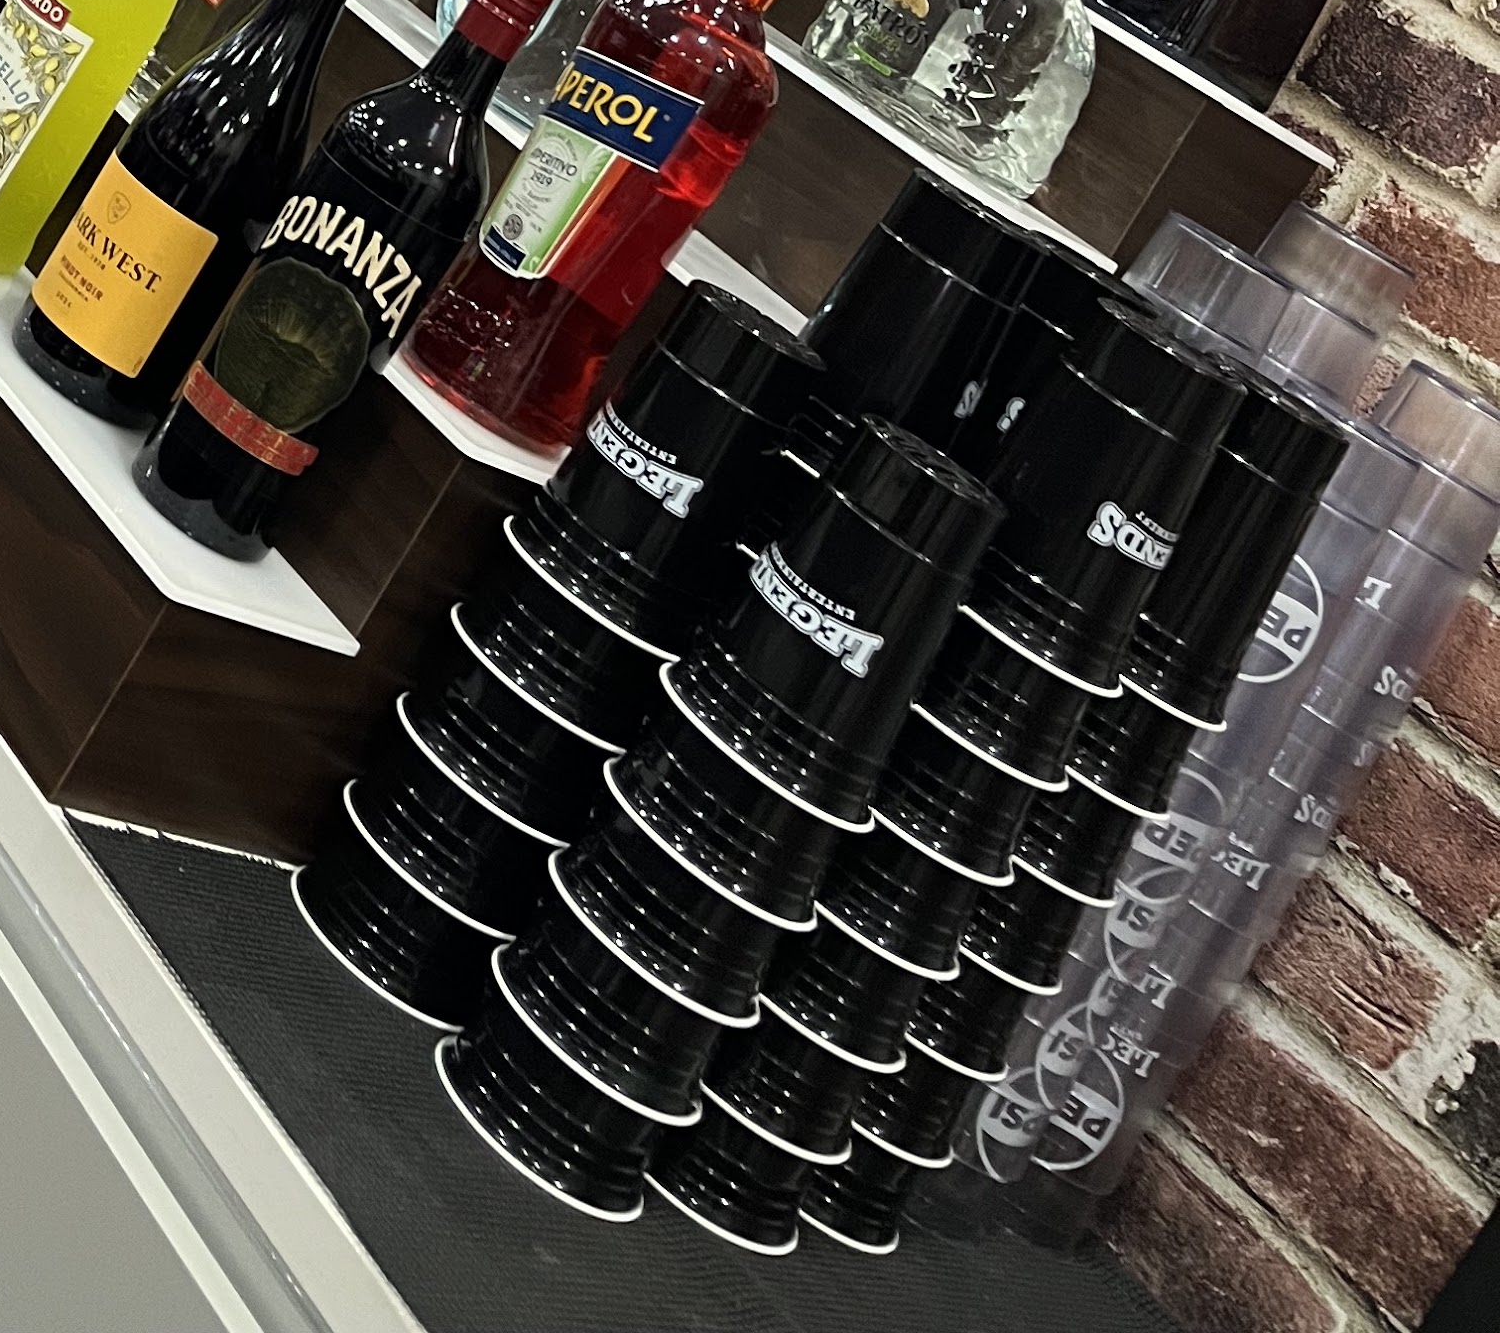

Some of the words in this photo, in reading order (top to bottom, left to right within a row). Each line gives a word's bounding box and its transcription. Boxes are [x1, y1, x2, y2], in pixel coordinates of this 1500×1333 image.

[553, 60, 659, 145] APEROL
[80, 276, 104, 302] NOIR
[260, 195, 422, 339] BONANZA
